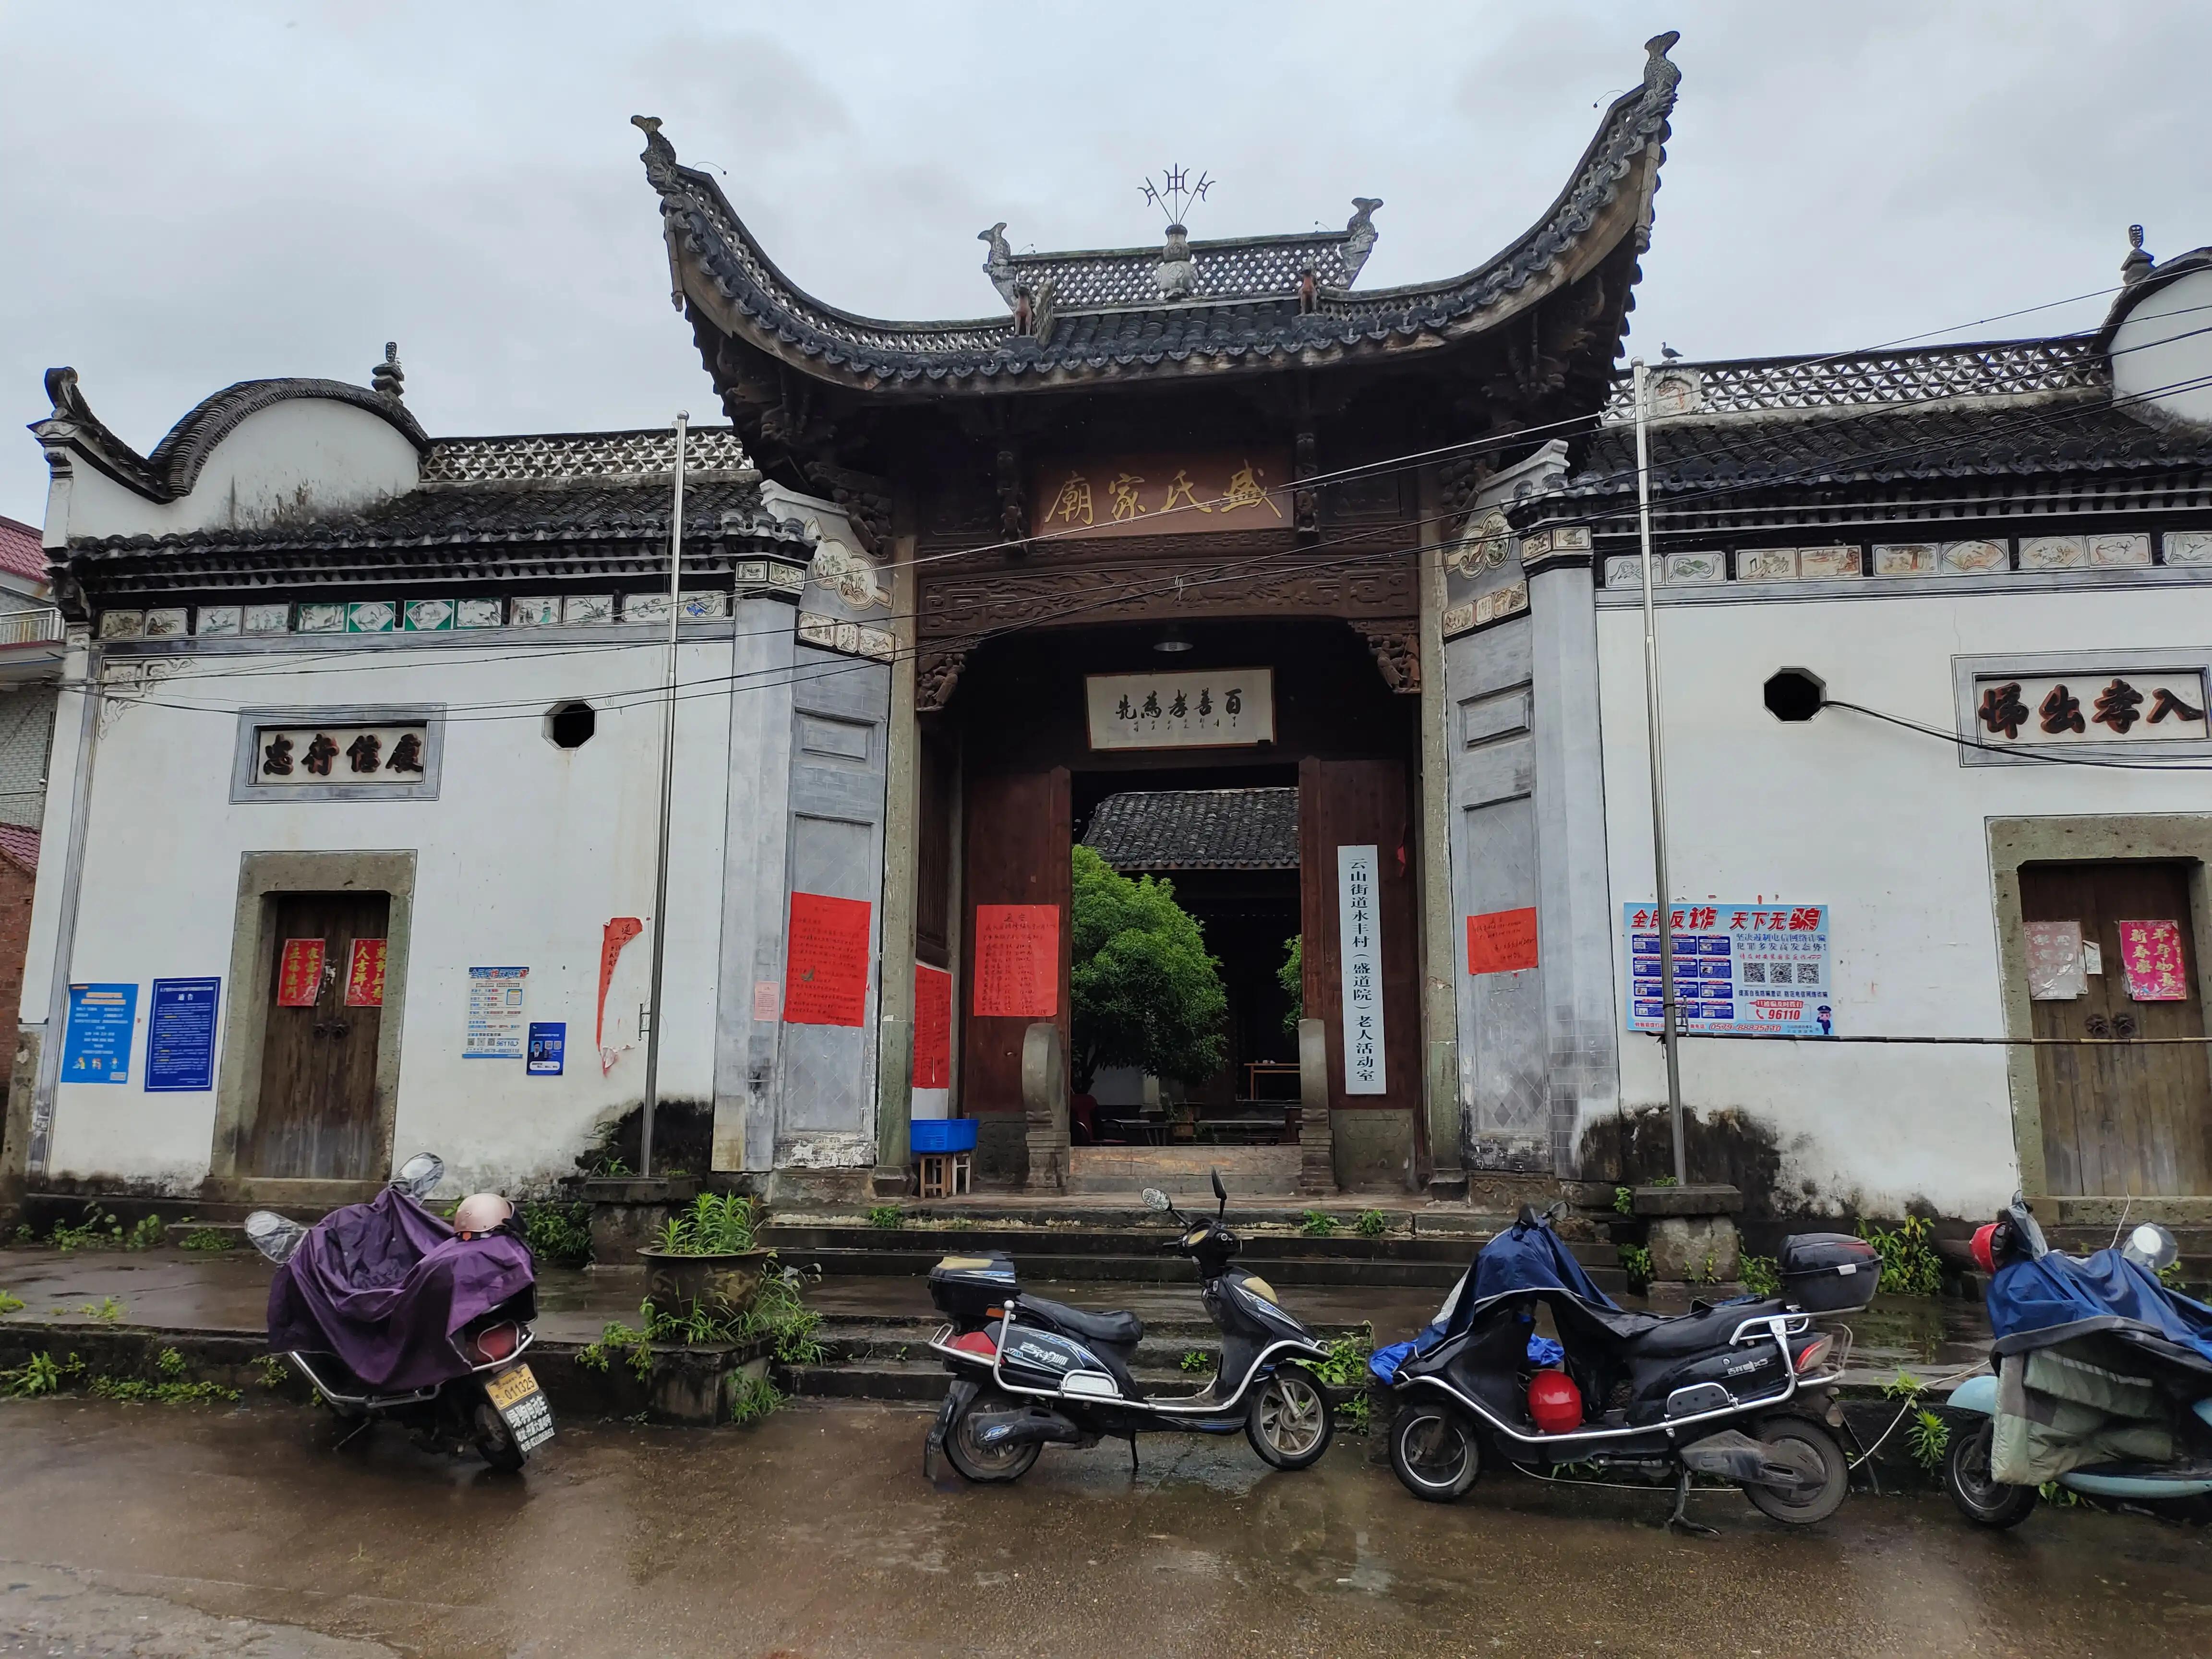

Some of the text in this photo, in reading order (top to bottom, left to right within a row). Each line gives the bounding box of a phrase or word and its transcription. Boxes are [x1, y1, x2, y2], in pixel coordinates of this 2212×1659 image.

[1729, 907, 1822, 931] 天下无骗
[1768, 1010, 1800, 1020] 96110
